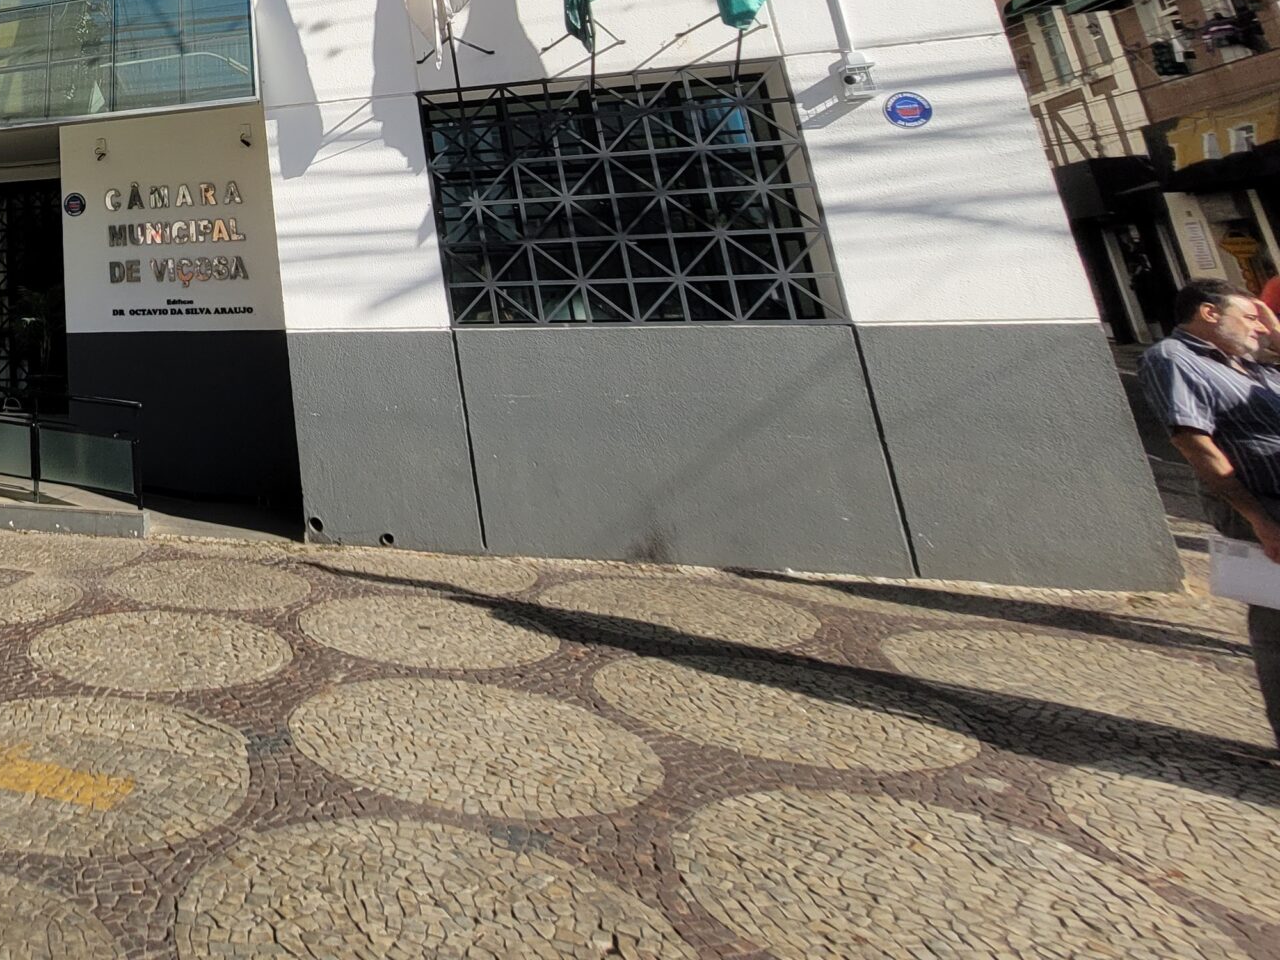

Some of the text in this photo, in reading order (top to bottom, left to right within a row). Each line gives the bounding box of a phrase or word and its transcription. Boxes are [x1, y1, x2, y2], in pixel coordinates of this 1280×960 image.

[105, 180, 243, 211] CÂMARA
[108, 217, 247, 248] MUNICIPAL
[108, 256, 249, 289] DE VIÇOSA
[112, 309, 125, 317] DR
[129, 308, 169, 316] OCTAVIO
[185, 307, 212, 315] SILVA
[213, 306, 254, 315] ARAUJO
